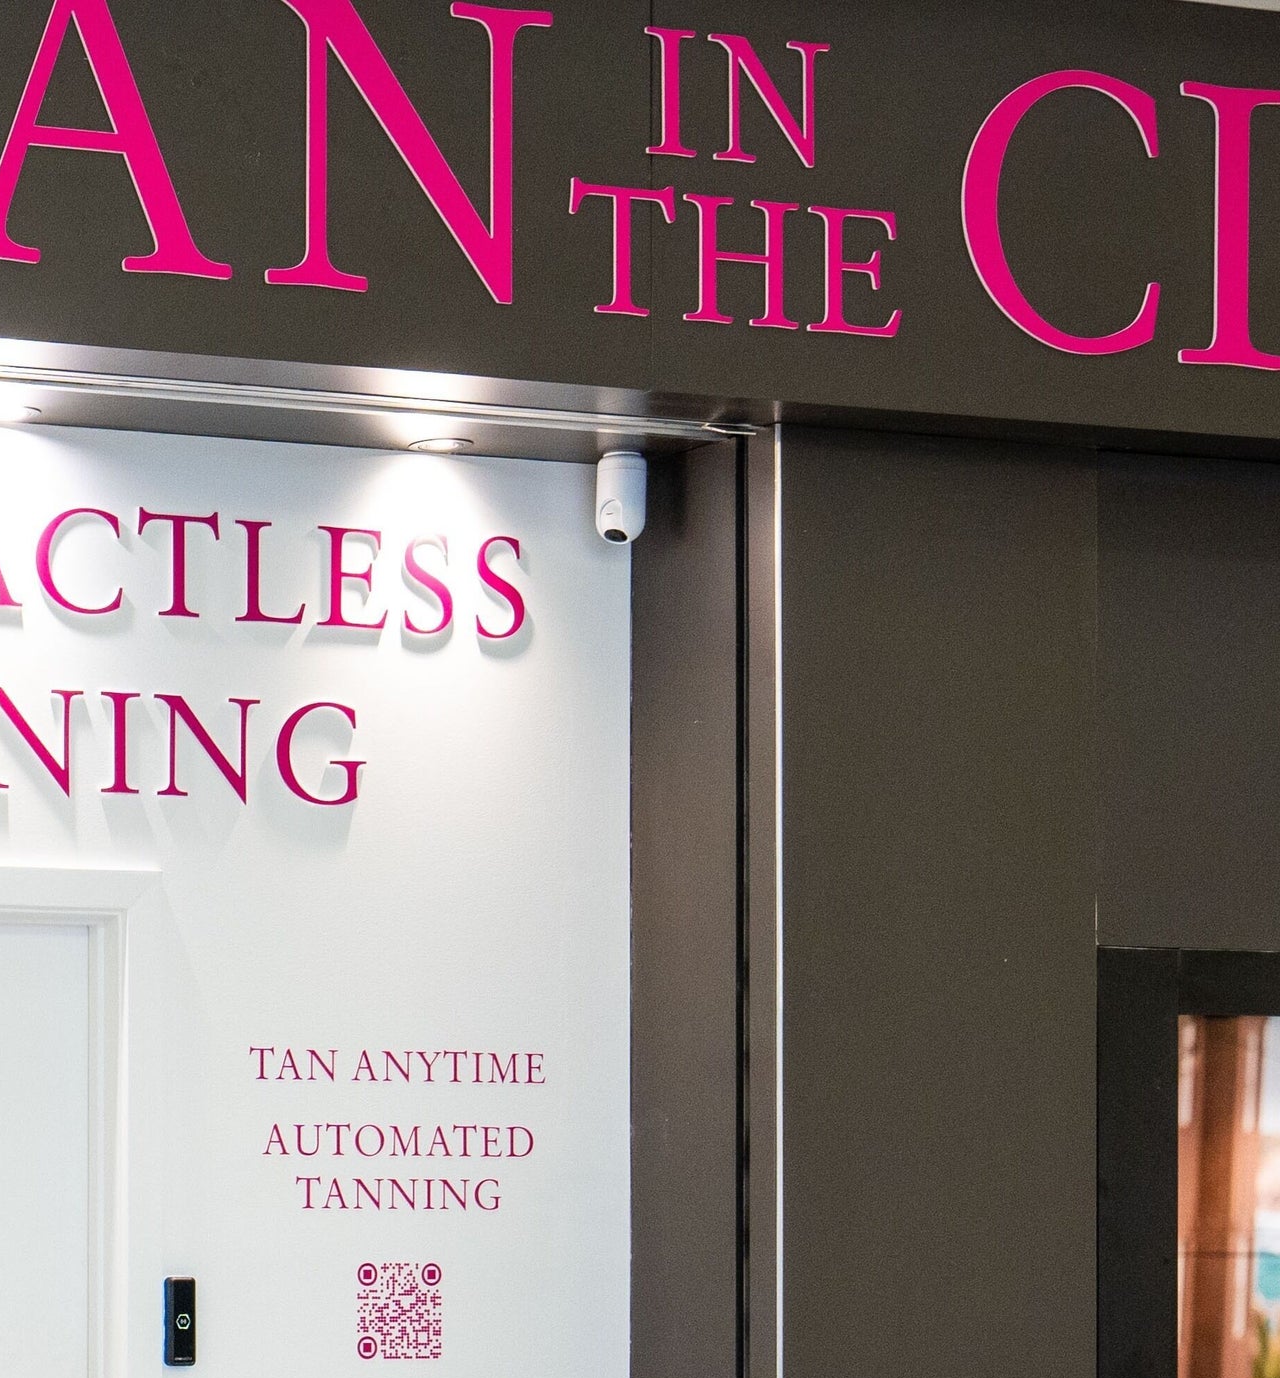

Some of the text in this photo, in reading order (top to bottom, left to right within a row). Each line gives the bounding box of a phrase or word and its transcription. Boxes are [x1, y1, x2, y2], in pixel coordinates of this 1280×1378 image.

[646, 25, 830, 168] IN
[570, 176, 903, 338] THE
[248, 1046, 547, 1084] TAN ANYTIME
[262, 1123, 535, 1158] AUTOMATED
[295, 1175, 502, 1211] TANNING
